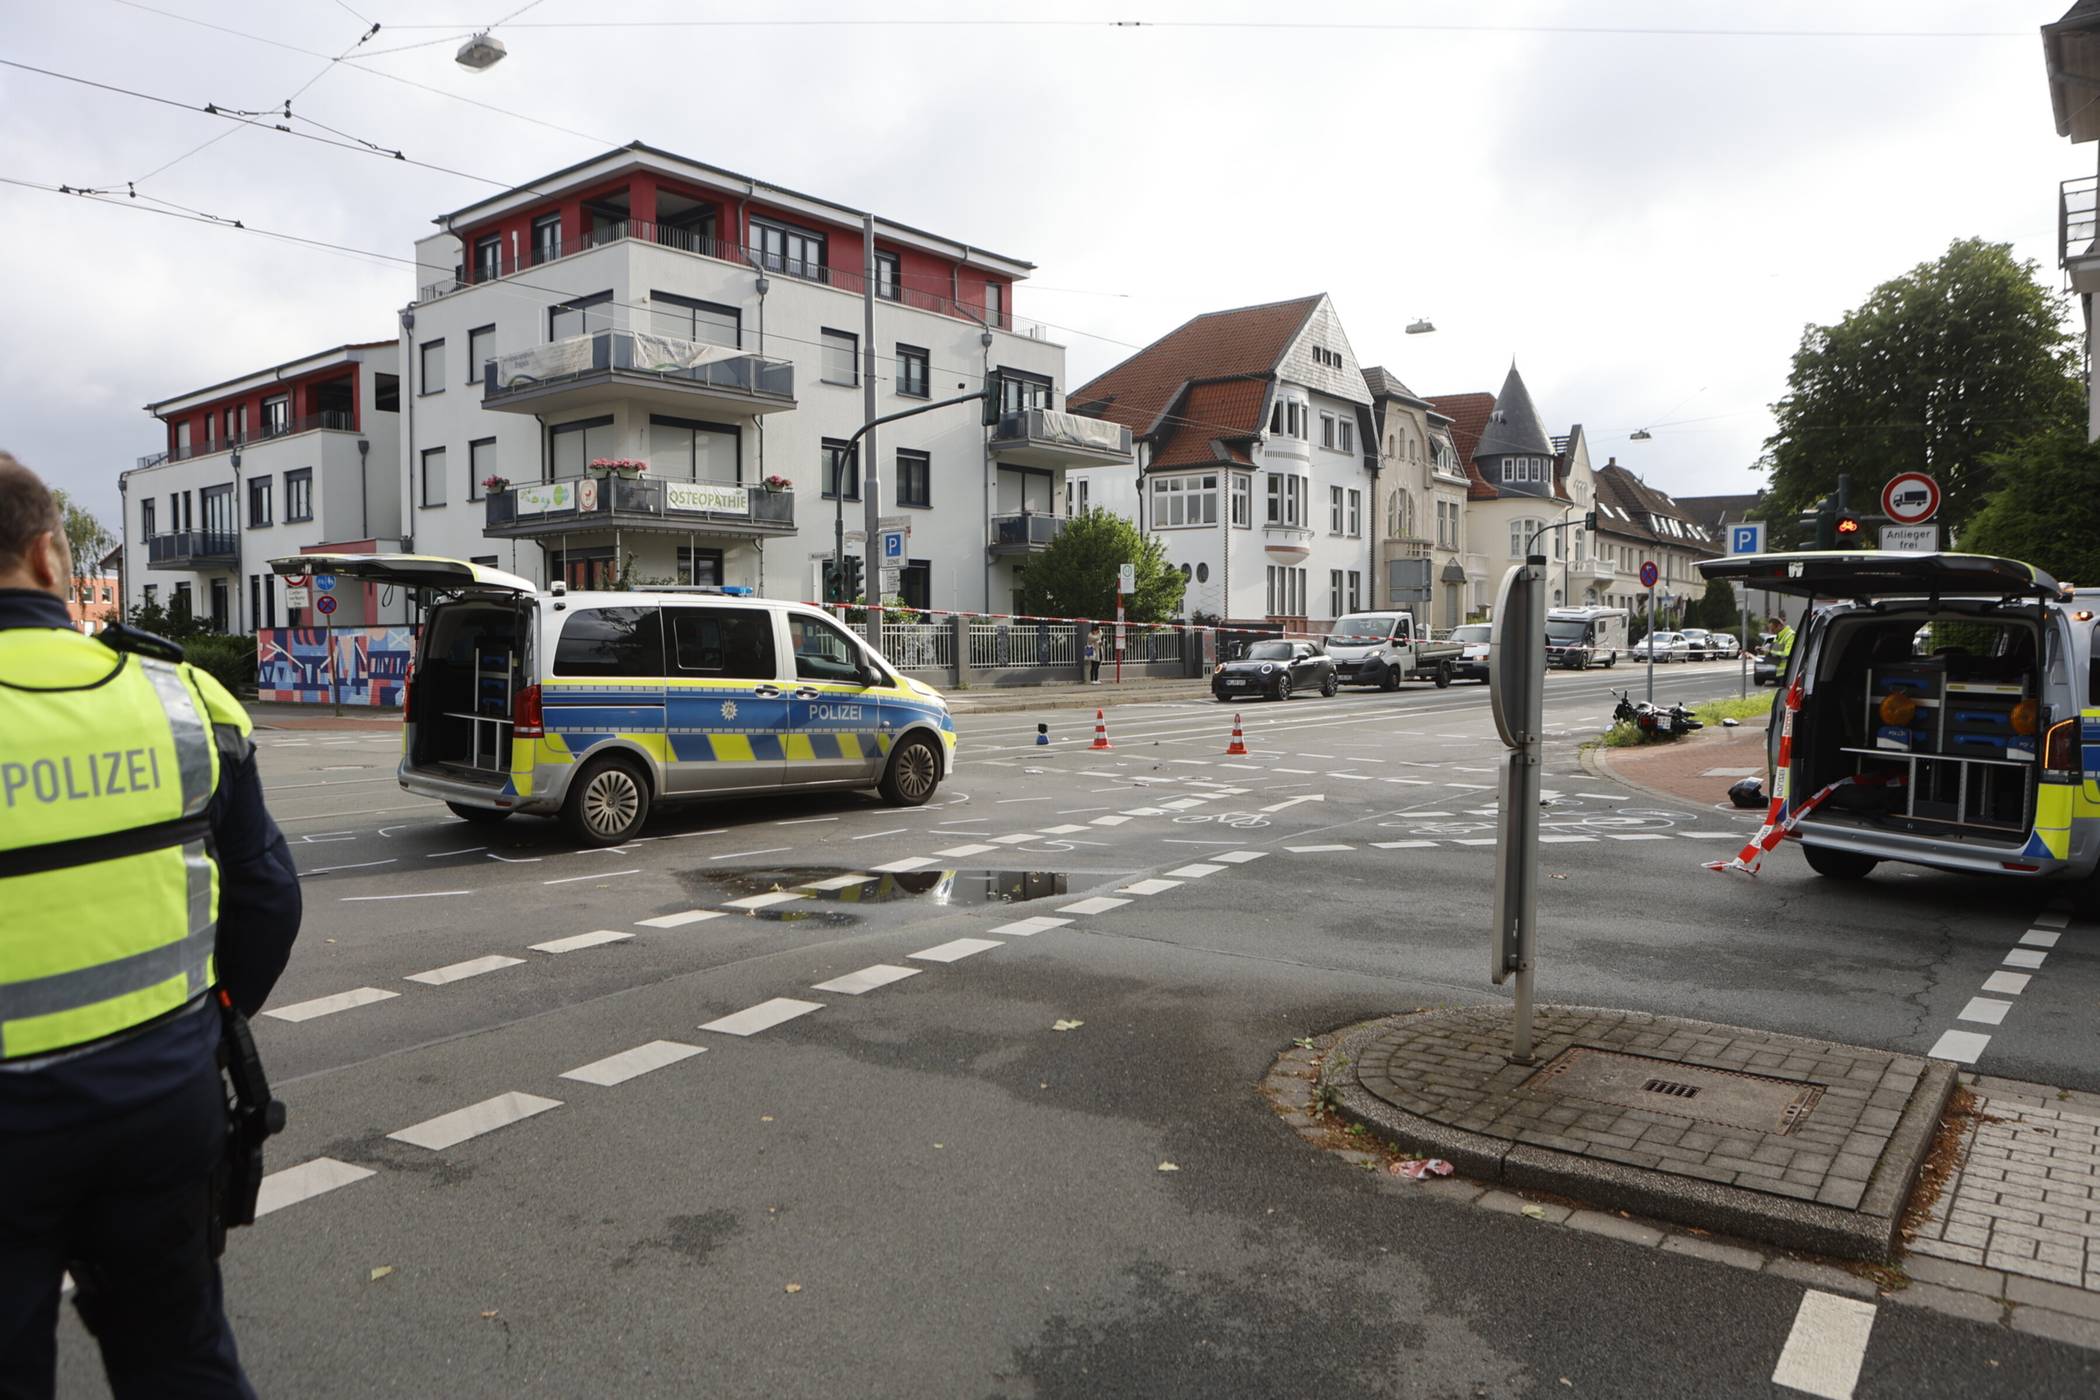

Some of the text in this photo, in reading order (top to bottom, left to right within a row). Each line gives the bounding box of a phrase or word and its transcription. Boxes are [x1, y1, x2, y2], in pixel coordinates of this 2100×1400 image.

[669, 489, 746, 509] OSTEOPATHIE
[1738, 531, 1752, 550] P
[1887, 530, 1930, 540] Anlieger
[888, 538, 898, 554] P
[1900, 541, 1918, 549] frei
[809, 704, 862, 721] POLIZEI
[1, 747, 161, 808] POLIZEI
